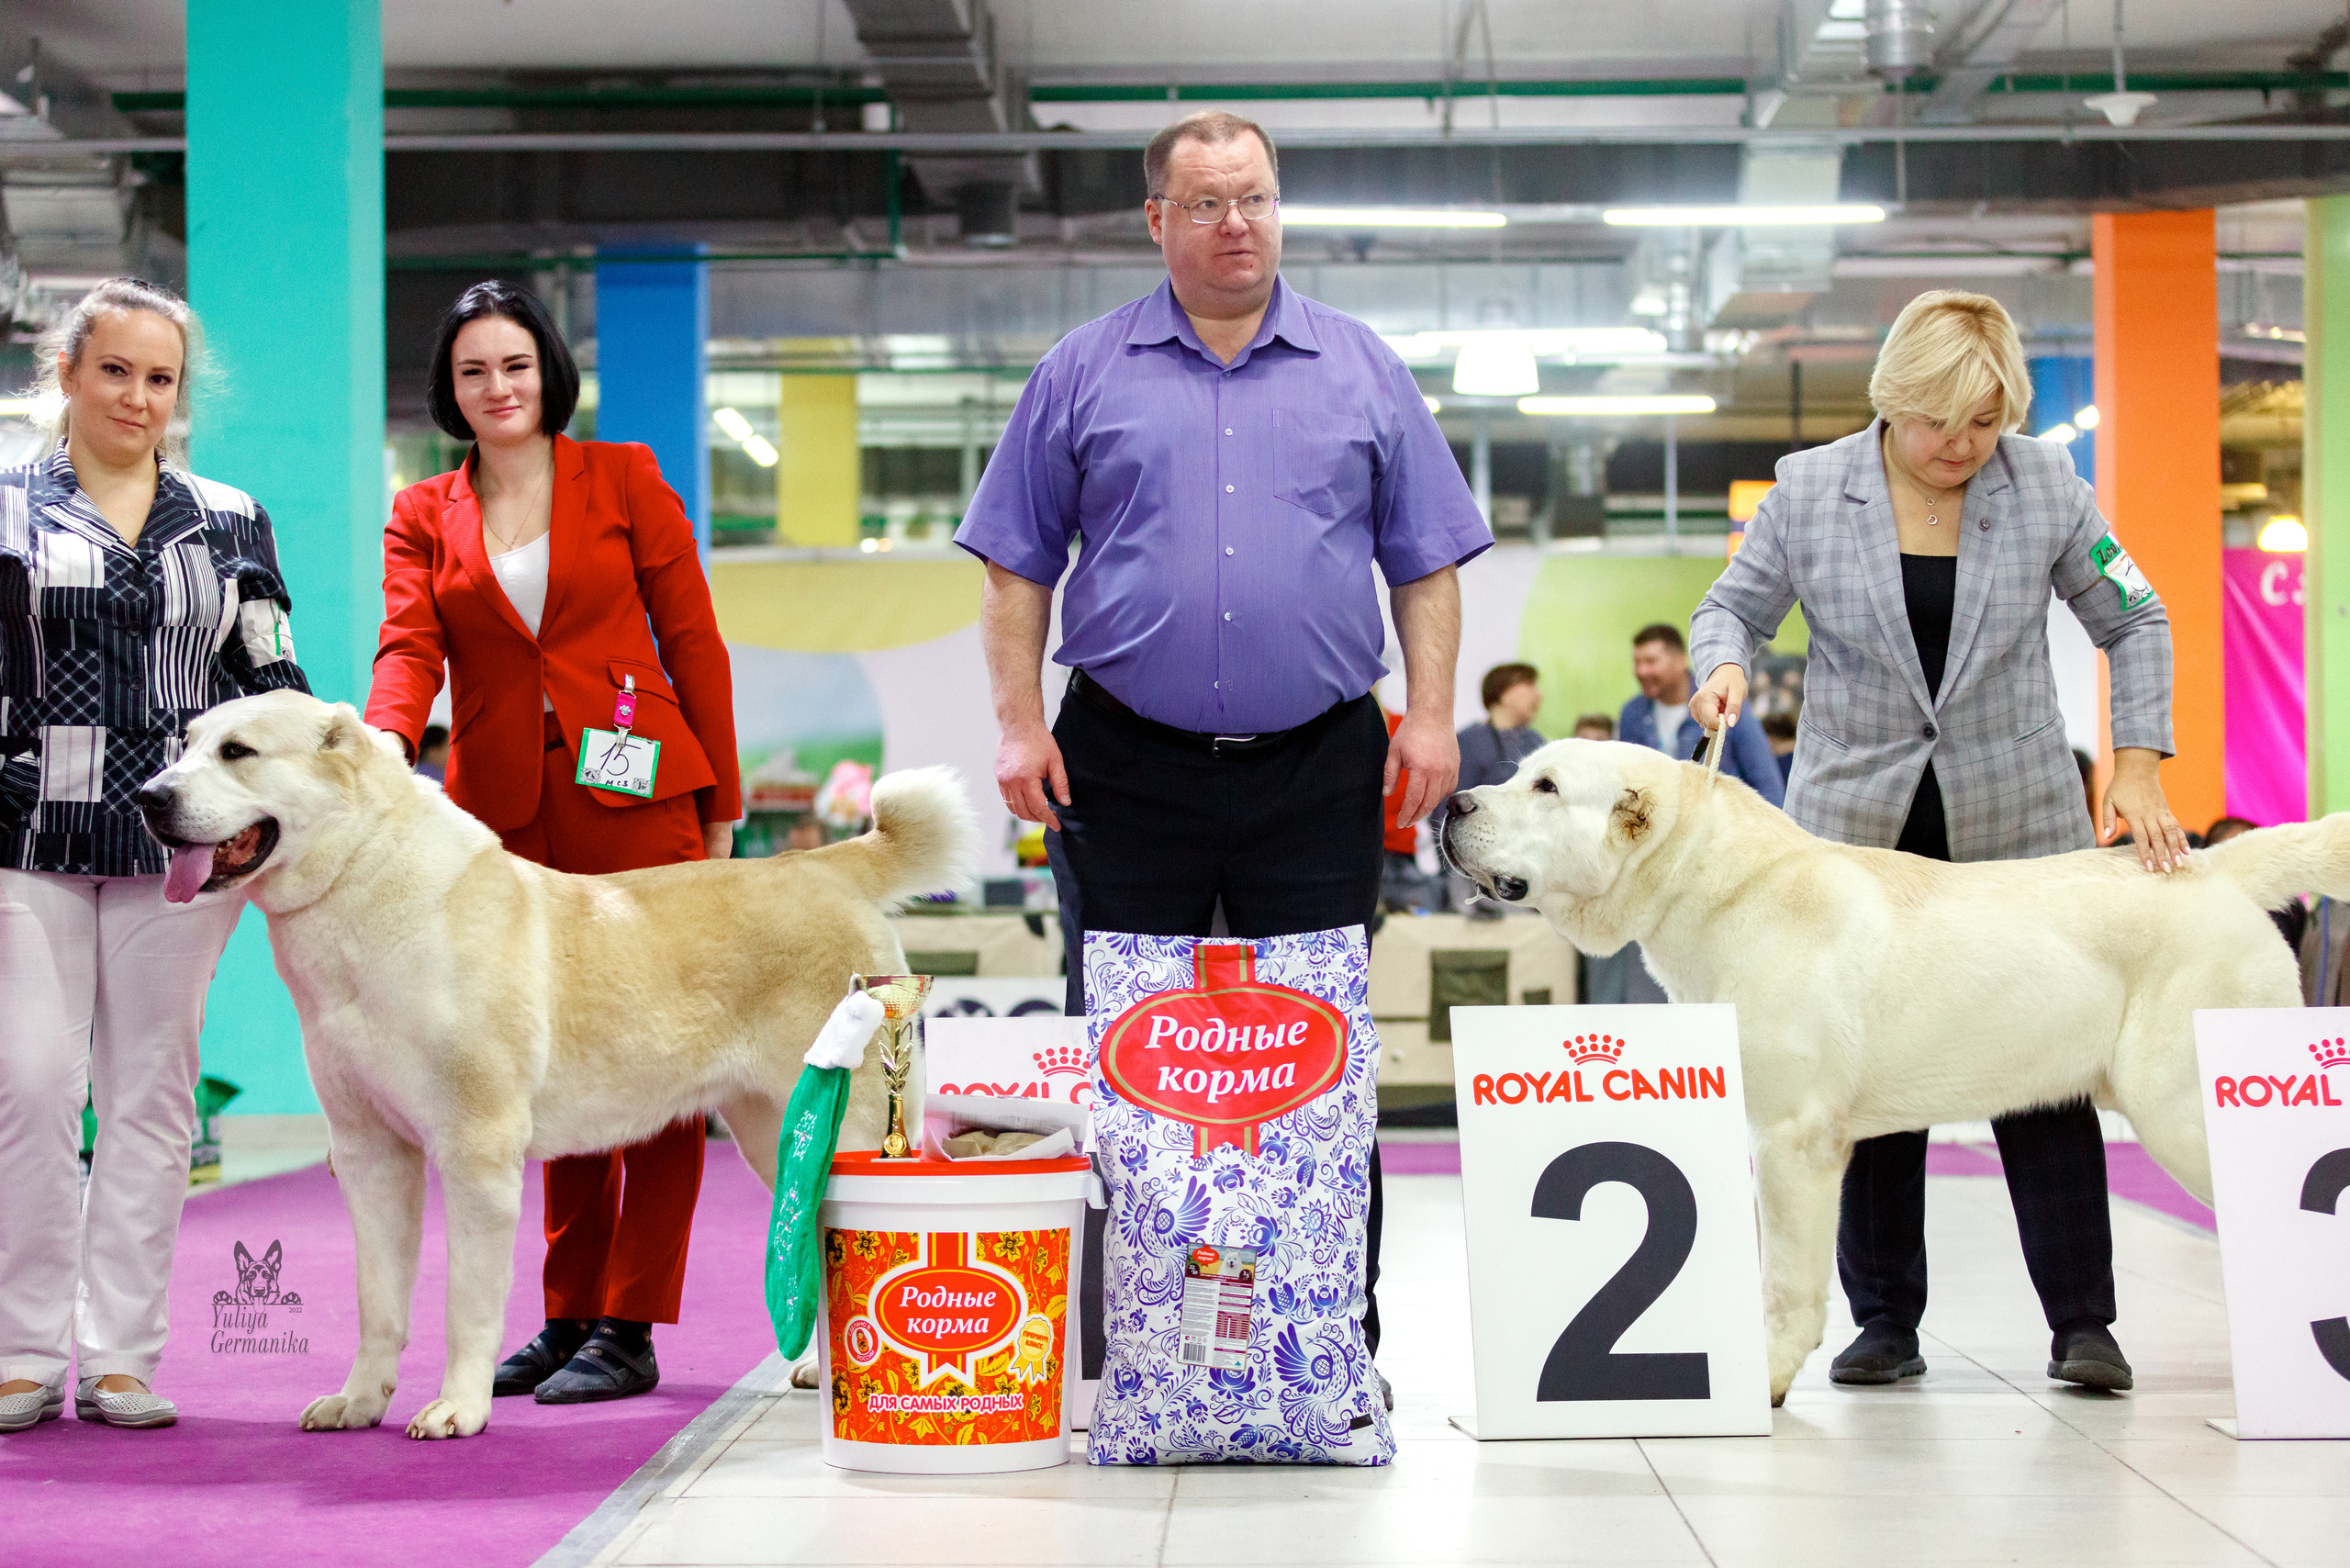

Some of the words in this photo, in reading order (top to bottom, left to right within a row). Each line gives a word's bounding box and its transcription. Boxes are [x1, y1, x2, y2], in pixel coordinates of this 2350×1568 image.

[599, 742, 642, 777] 15
[1144, 1014, 1309, 1053] Родные
[1157, 1062, 1297, 1103] корма
[1472, 1070, 1595, 1106] ROYAL
[1602, 1066, 1727, 1101] CANIN
[2215, 1074, 2343, 1108] ROYAL
[1530, 1141, 1711, 1402] 2
[899, 1285, 997, 1308] Родные
[907, 1316, 990, 1339] корма
[1023, 1330, 1049, 1343] ПРЕМИУМ
[1025, 1339, 1044, 1350] КЛАСС
[869, 1395, 897, 1412] ДЛЯ
[901, 1396, 957, 1411] САМЫХ
[961, 1394, 1023, 1413] РОДНЫХ
